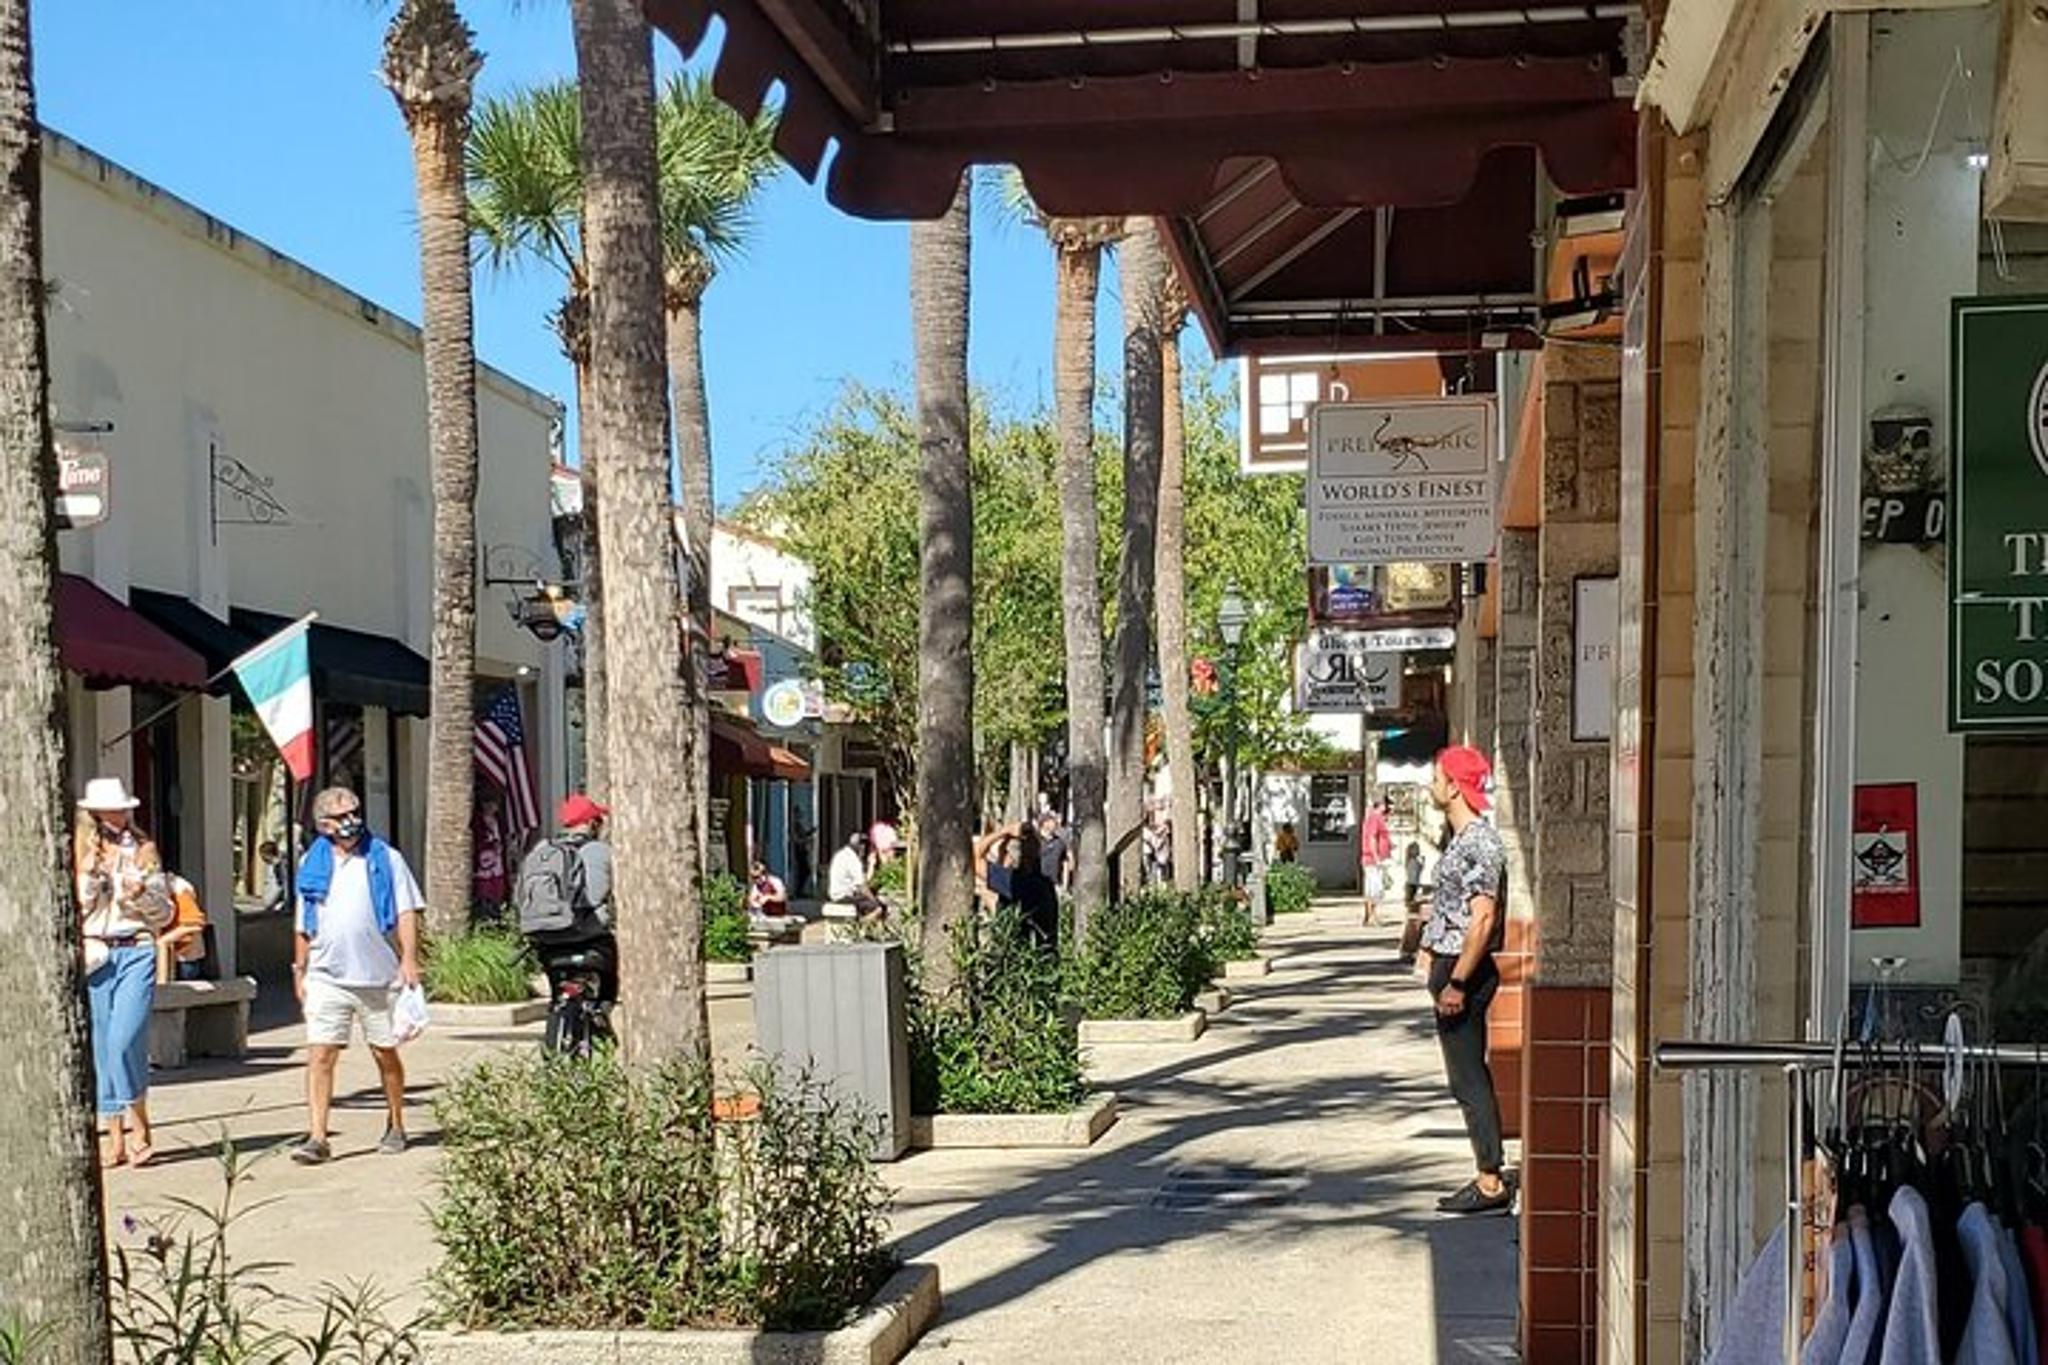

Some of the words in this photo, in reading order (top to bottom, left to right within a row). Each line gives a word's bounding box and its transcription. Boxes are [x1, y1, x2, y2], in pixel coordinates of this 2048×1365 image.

[1328, 432, 1478, 453] PRERIC
[1321, 482, 1411, 500] WORLD'S
[1418, 480, 1486, 498] FINEST
[2008, 596, 2048, 641] T
[1975, 658, 2048, 703] SO
